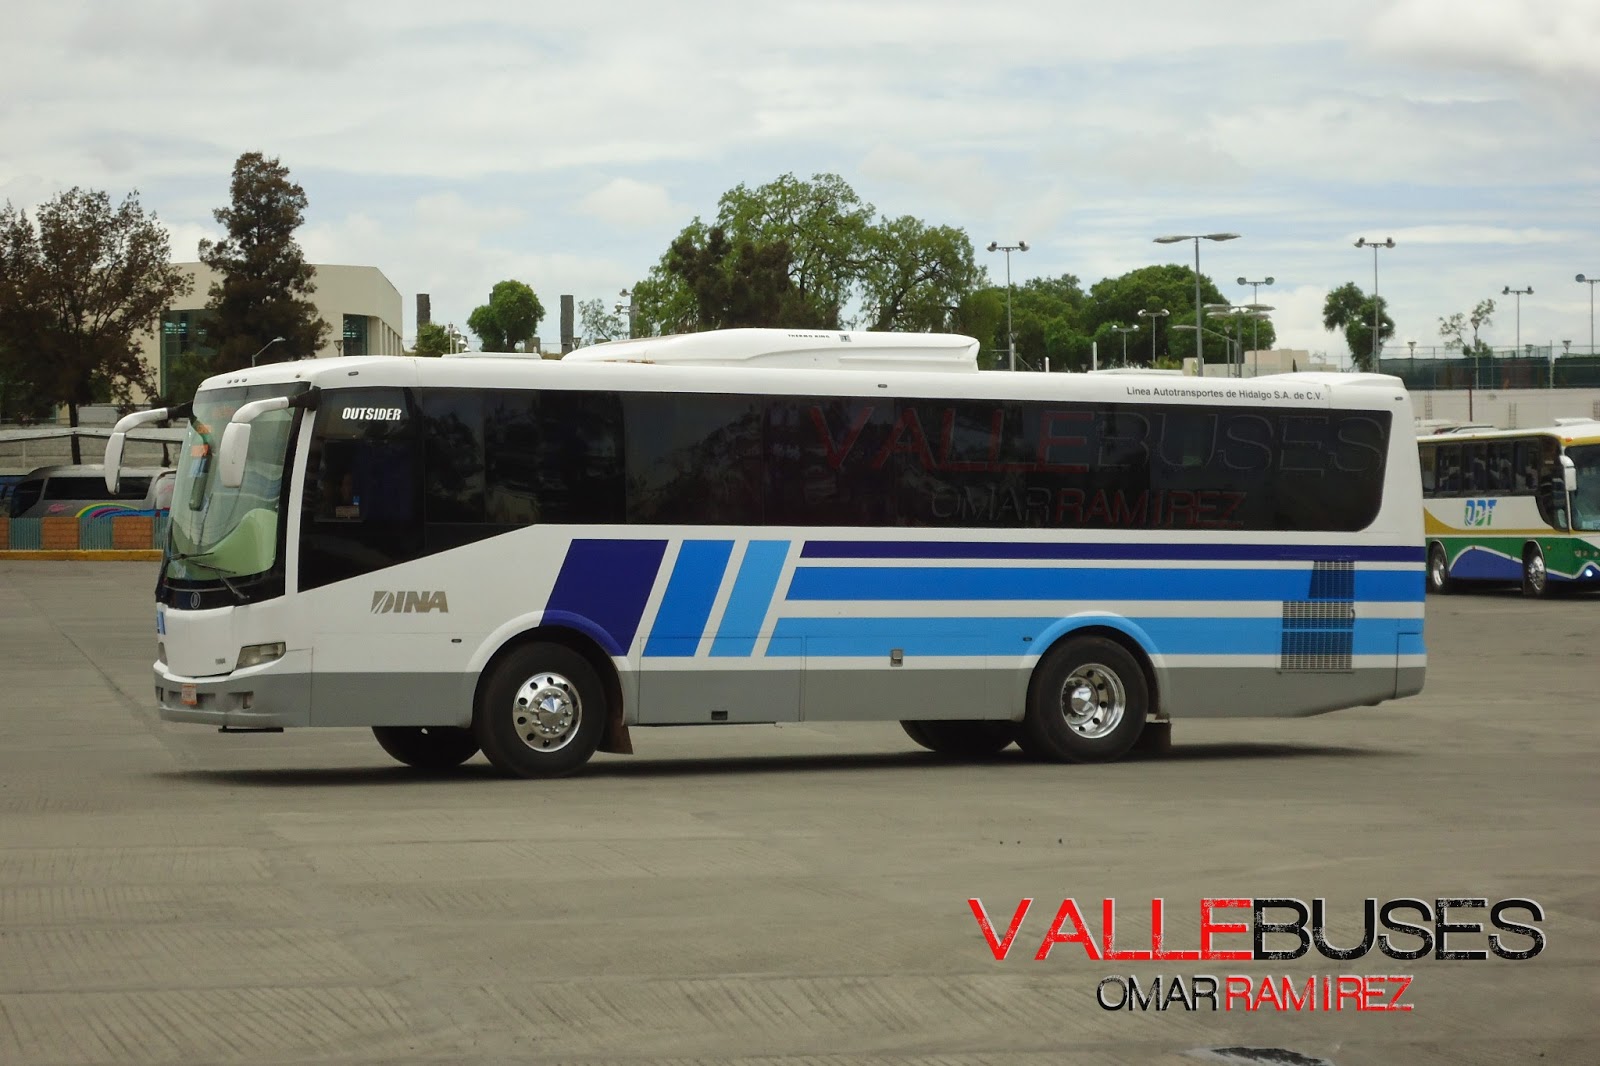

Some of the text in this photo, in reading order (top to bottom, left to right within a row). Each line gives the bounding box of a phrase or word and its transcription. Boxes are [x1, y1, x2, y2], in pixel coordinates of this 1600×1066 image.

[1153, 387, 1224, 398] Autotransportes
[1226, 390, 1237, 398] de
[1239, 390, 1272, 401] Hidalgo
[1274, 390, 1292, 400] S.A.
[1293, 391, 1305, 400] de
[1306, 391, 1324, 401] C.V.
[341, 407, 402, 421] OUTSIDER
[370, 590, 449, 614] DINA
